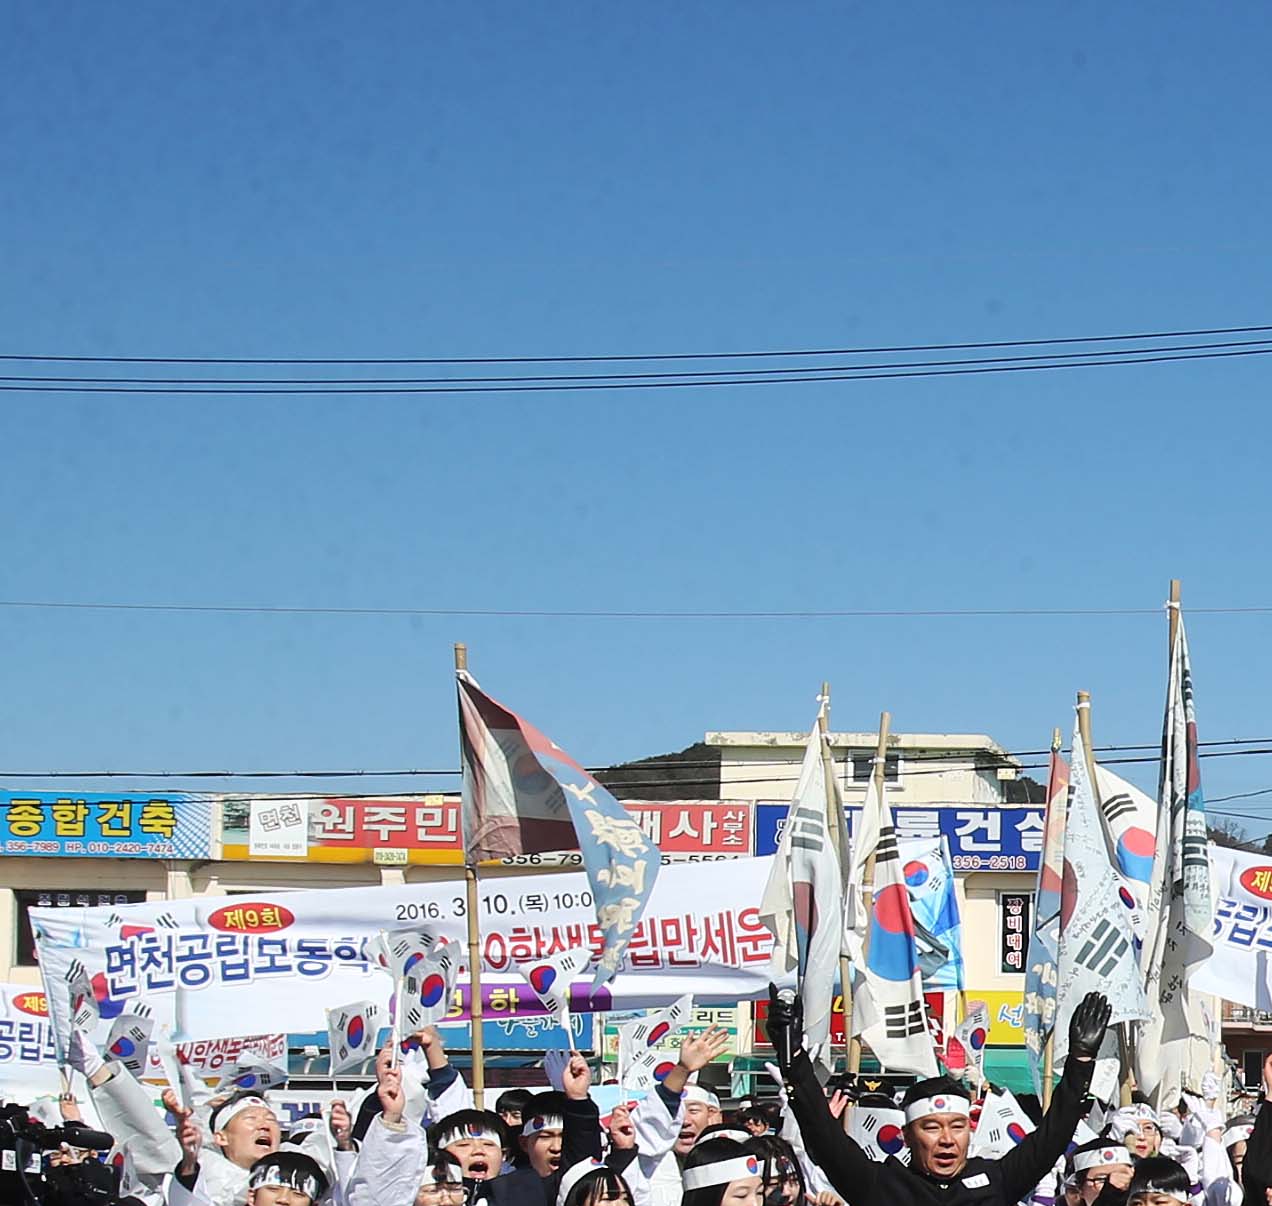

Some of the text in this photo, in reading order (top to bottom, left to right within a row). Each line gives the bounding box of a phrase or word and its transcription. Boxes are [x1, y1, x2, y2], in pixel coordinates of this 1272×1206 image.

[6, 799, 177, 839] 종합건축
[313, 805, 458, 842] 원주민
[721, 811, 745, 846] 사무소
[952, 855, 1027, 869] 356-2518
[519, 893, 549, 915] (목)
[554, 891, 593, 910] 10:0
[224, 907, 283, 930] 제9회
[22, 999, 49, 1013] 제9
